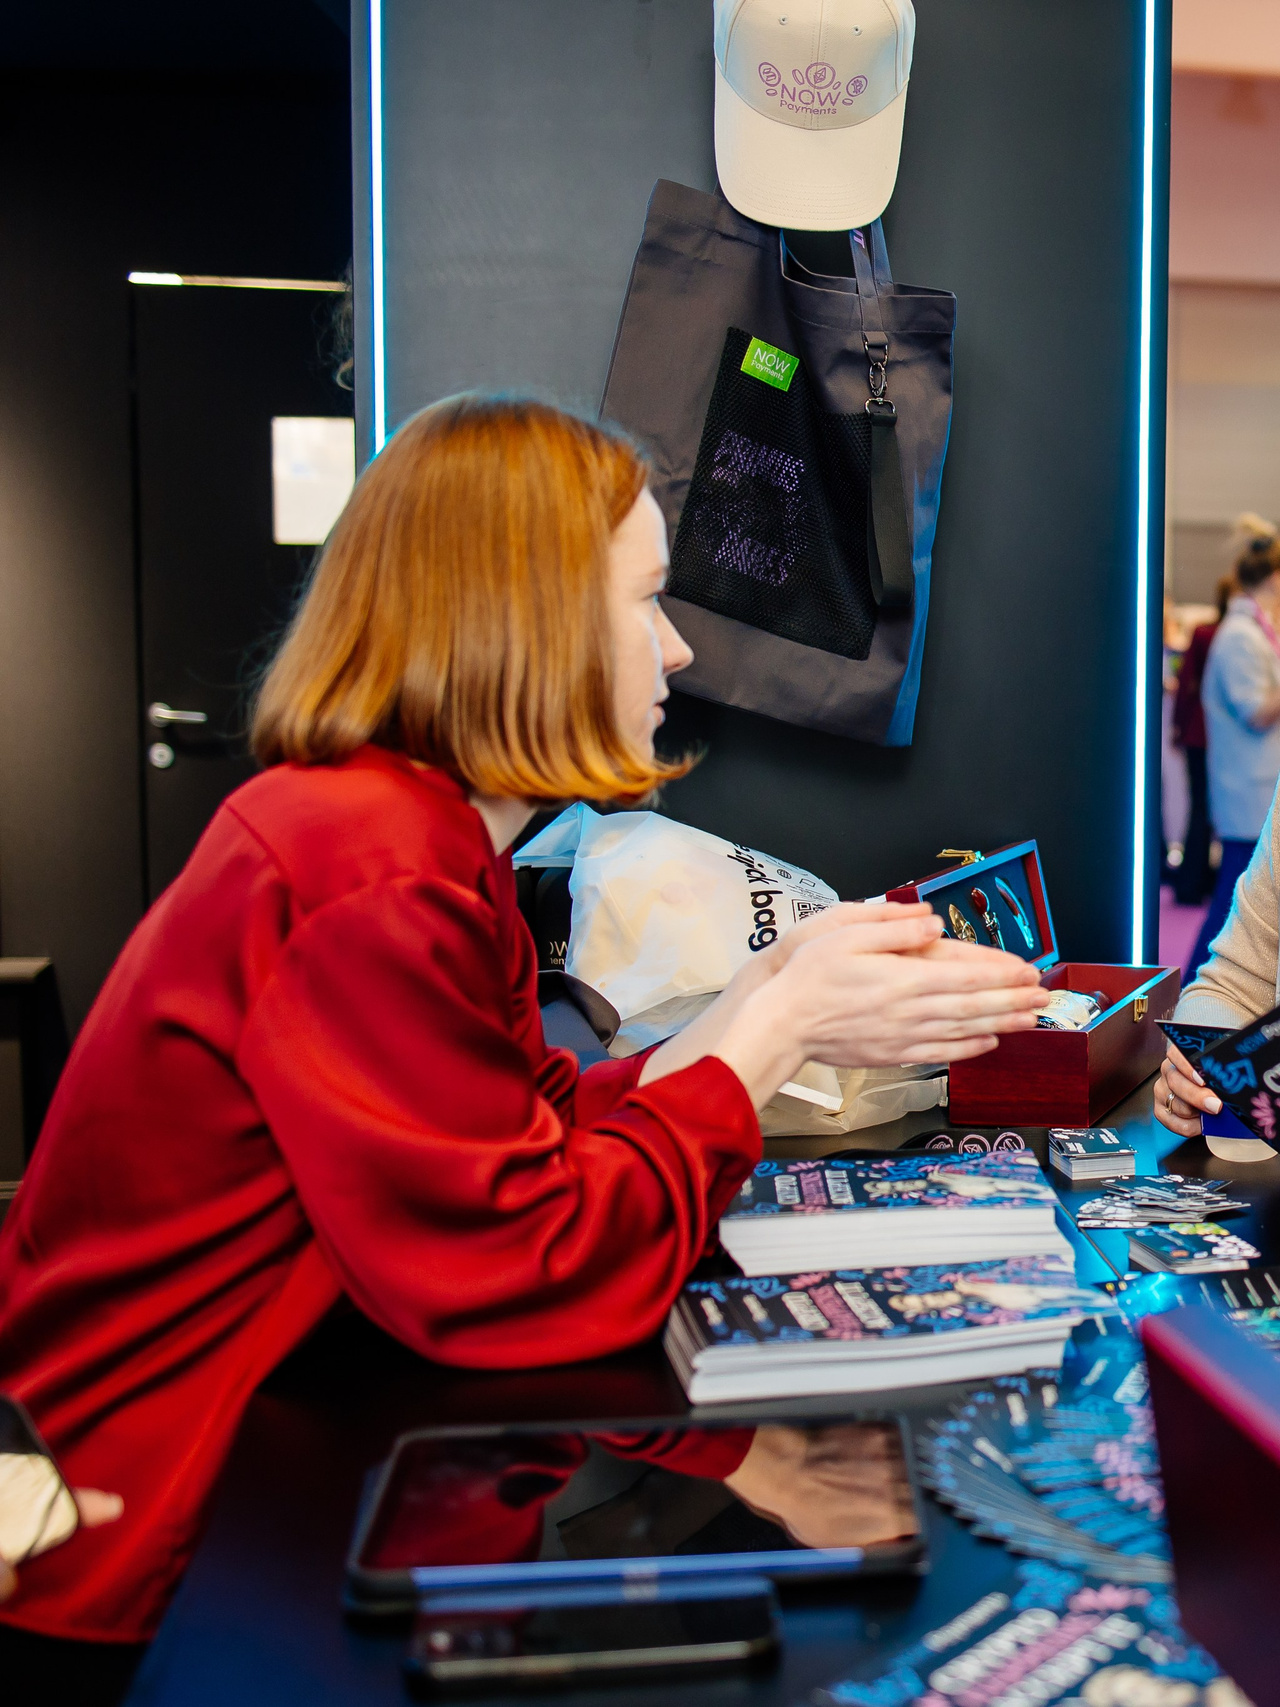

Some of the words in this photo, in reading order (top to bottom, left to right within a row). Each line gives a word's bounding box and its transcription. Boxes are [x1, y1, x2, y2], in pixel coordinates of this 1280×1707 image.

[780, 83, 841, 107] NOW
[780, 99, 837, 115] Payments
[753, 347, 791, 374] NOW
[748, 890, 783, 952] bag
